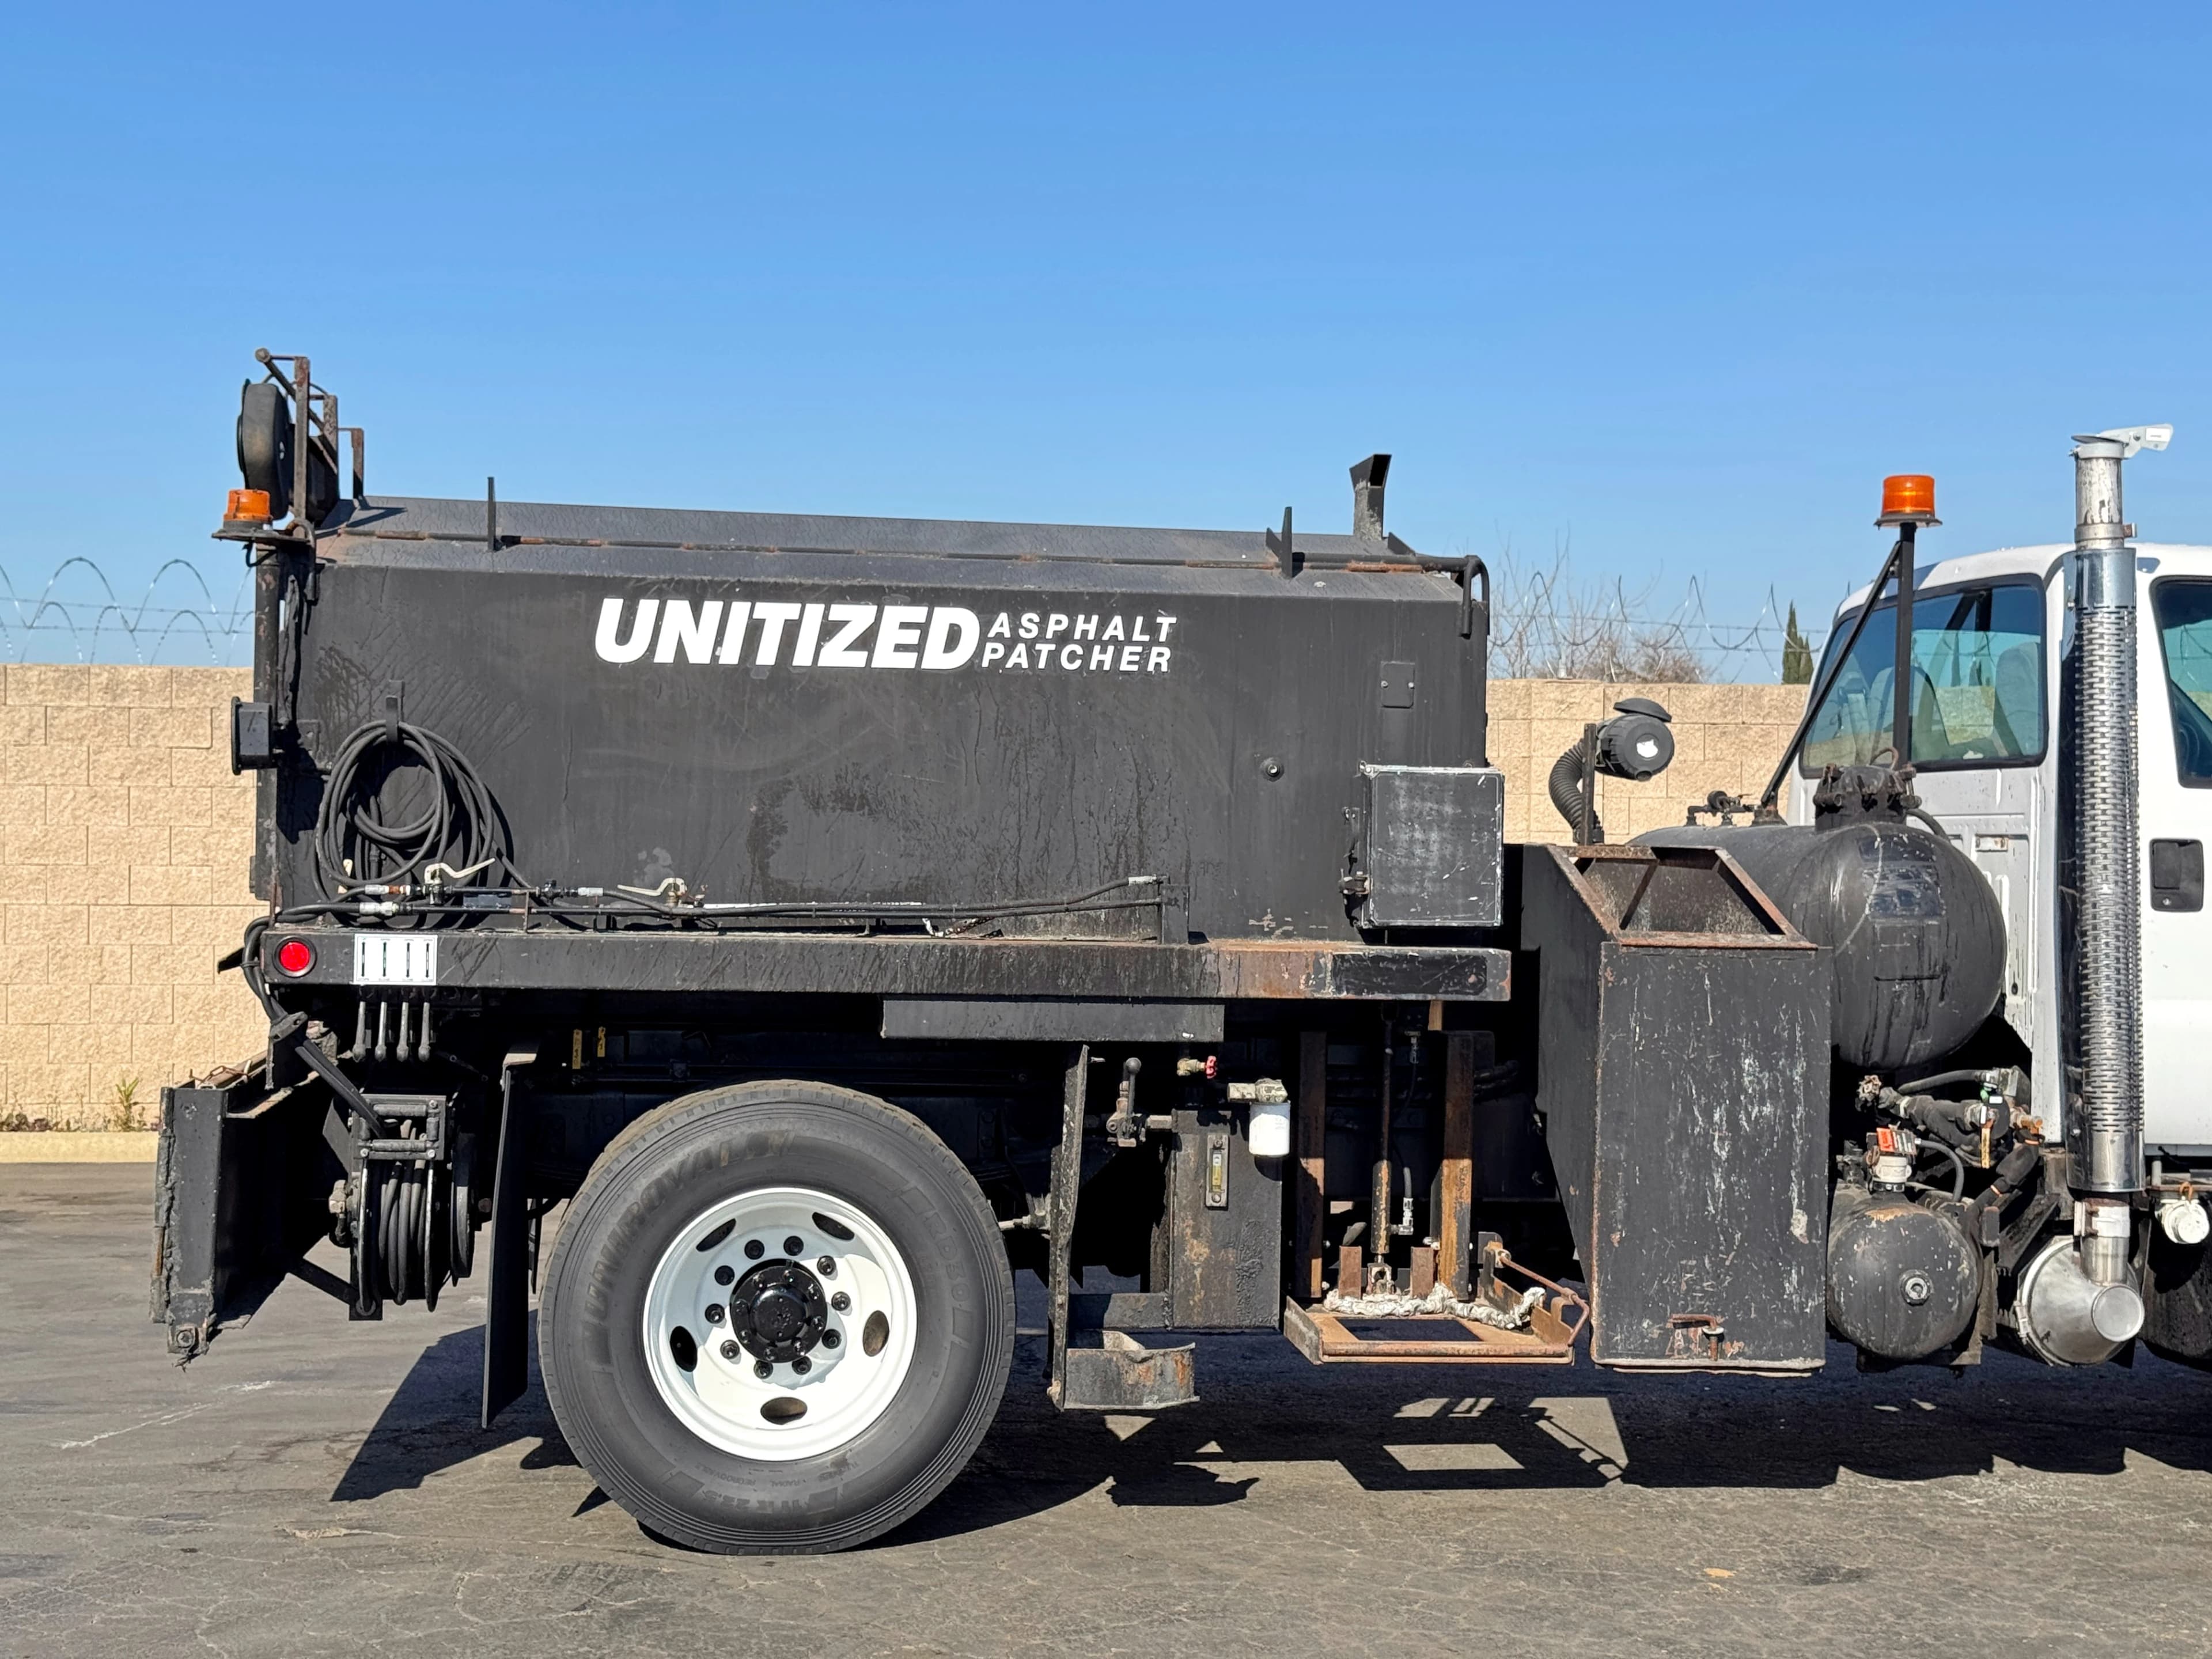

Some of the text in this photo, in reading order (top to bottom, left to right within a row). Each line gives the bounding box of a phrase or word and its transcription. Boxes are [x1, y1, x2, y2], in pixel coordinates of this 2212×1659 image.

[595, 598, 980, 669] UNITIZED
[982, 642, 1172, 672] PATCHER
[987, 612, 1177, 642] ASPHALT
[586, 1138, 744, 1321] UNIROYAL
[923, 1213, 970, 1302] RD30
